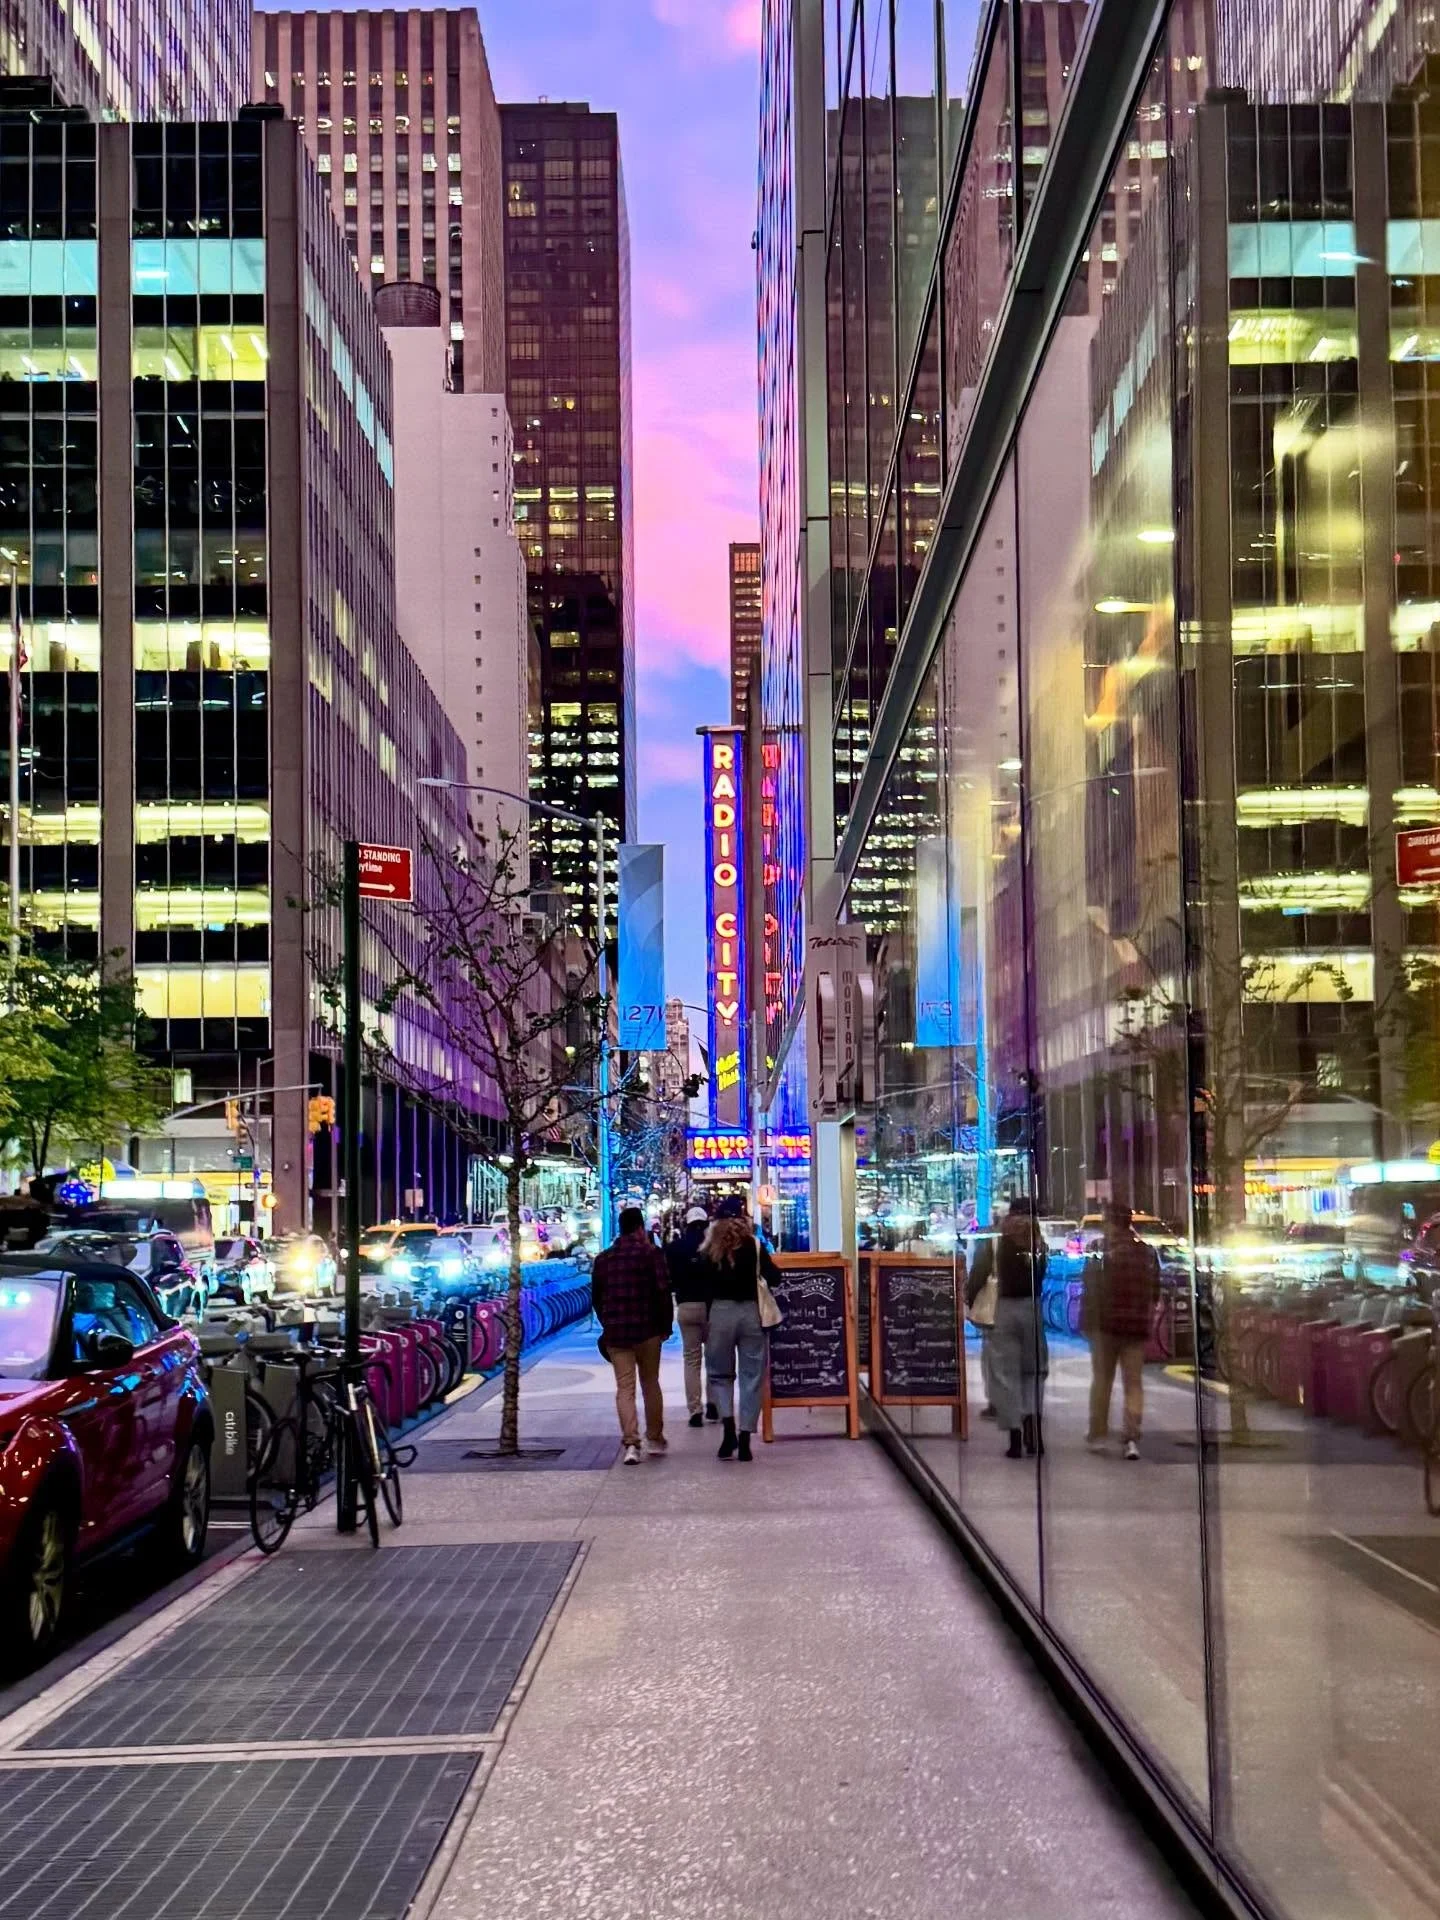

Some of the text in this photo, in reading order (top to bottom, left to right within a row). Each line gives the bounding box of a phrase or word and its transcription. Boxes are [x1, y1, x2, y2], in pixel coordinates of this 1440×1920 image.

[363, 849, 401, 863] STANDING
[713, 744, 739, 1026] RADIO CITY
[623, 1004, 663, 1025] 1271
[694, 1135, 748, 1148] RADIO
